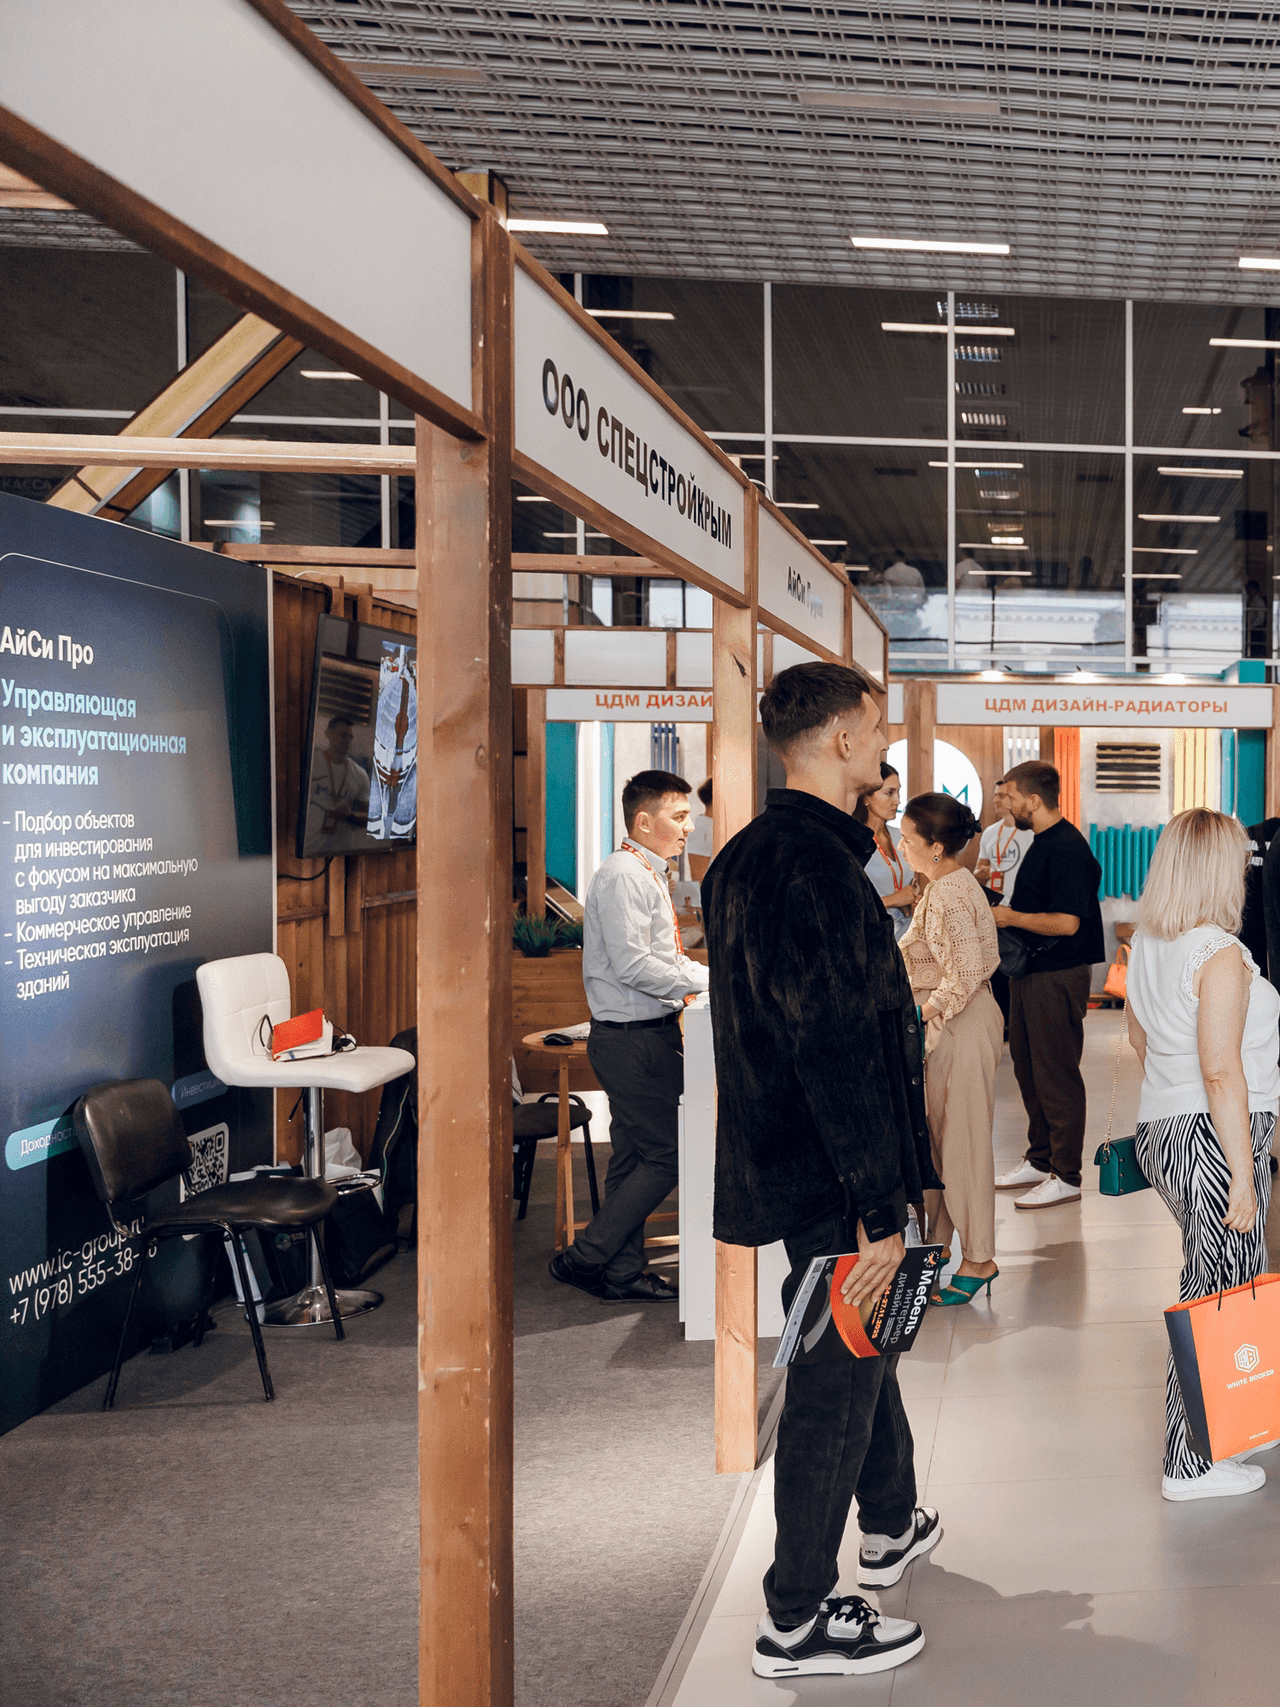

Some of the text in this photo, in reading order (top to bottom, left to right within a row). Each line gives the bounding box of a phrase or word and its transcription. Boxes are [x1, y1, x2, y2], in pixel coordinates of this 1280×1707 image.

[542, 358, 732, 549] ООО СПЕЦСТРОЙКРЫМ
[0, 626, 94, 669] АйСи Про
[1, 678, 137, 720] Управляющая
[596, 694, 640, 709] ЦДМ
[985, 696, 1228, 714] ЦДМ ДИЗАЙН-РАДИАТОРЫ
[2, 725, 187, 756] и эксплуатационная
[2, 763, 99, 786] компания
[15, 810, 71, 834] Подбор
[75, 810, 135, 830] объектов
[15, 835, 153, 862] для инвестирования
[15, 857, 198, 891] с фокусом на максимальную
[16, 886, 136, 916] выгоду заказчика
[16, 915, 120, 943] Коммерческое
[122, 904, 191, 931] управление
[17, 940, 106, 971] Техническая
[109, 927, 190, 955] эксплуатация
[16, 971, 70, 1000] зданий
[10, 1297, 29, 1325] +7
[35, 1273, 73, 1320] (978)
[904, 1270, 934, 1335] Мебель
[890, 1289, 913, 1344] интерьер
[1226, 1369, 1275, 1390] WHITE BROKER
